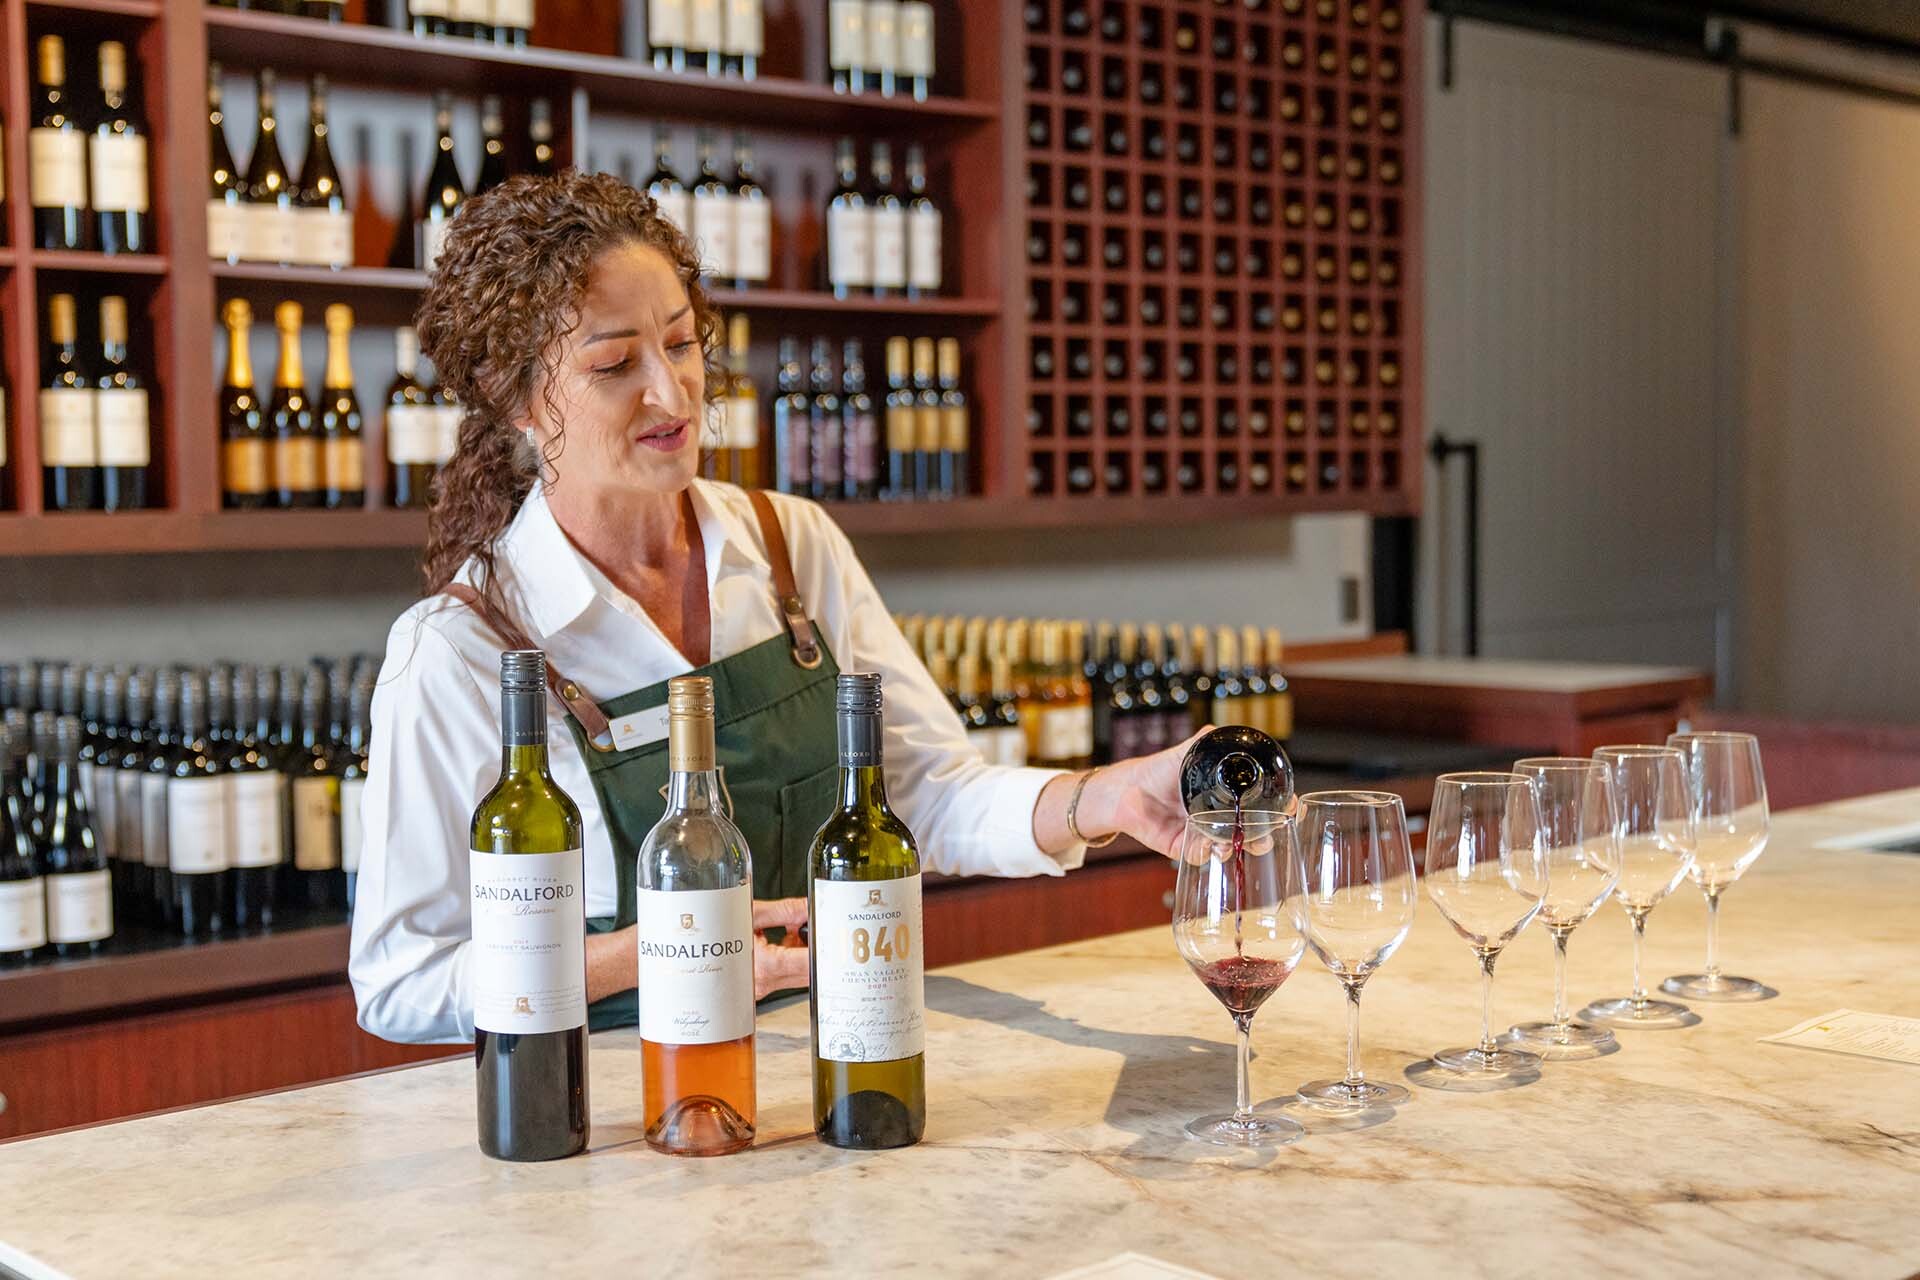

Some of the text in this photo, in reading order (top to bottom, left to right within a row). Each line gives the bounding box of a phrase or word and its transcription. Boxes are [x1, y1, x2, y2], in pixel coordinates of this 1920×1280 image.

[475, 884, 574, 902] SANDALFORD
[848, 911, 902, 921] SANDALFORD
[641, 939, 743, 959] SANDALFORD
[845, 923, 910, 963] 840
